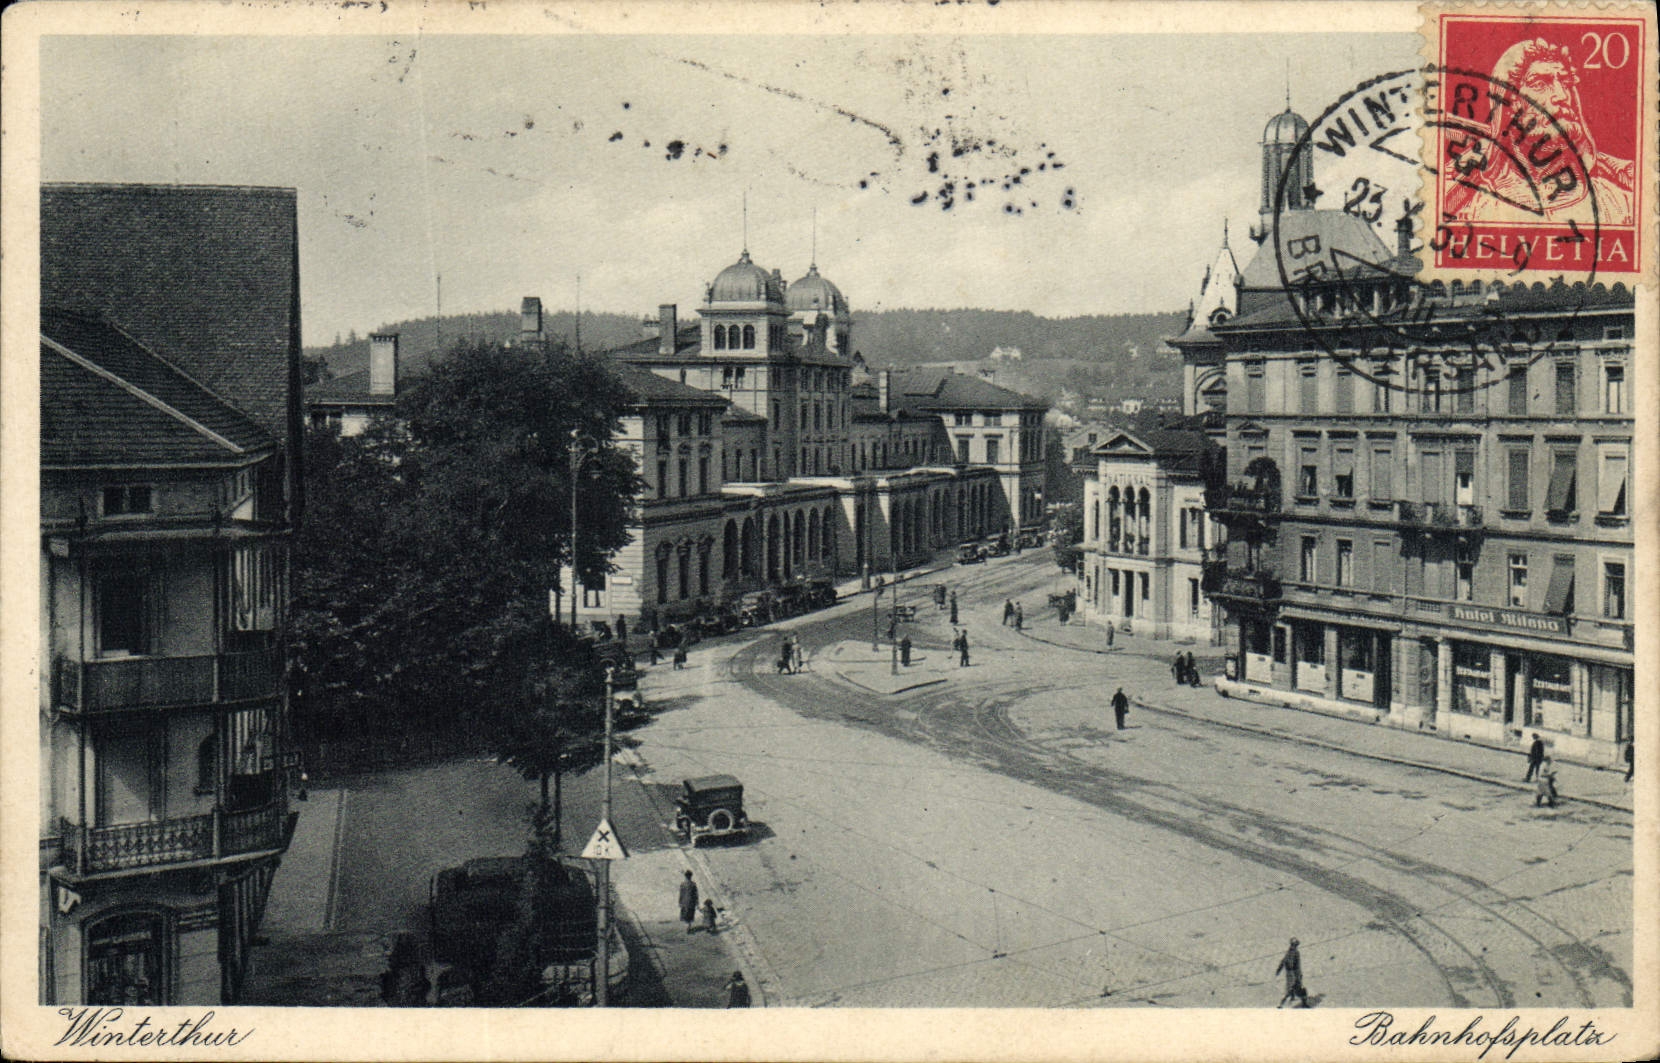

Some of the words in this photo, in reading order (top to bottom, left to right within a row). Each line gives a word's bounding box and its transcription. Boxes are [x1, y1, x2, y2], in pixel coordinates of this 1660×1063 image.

[1581, 32, 1630, 70] 20
[1448, 234, 1629, 263] HELVETIA
[1454, 607, 1495, 623] Hotel
[1501, 612, 1559, 632] Milano
